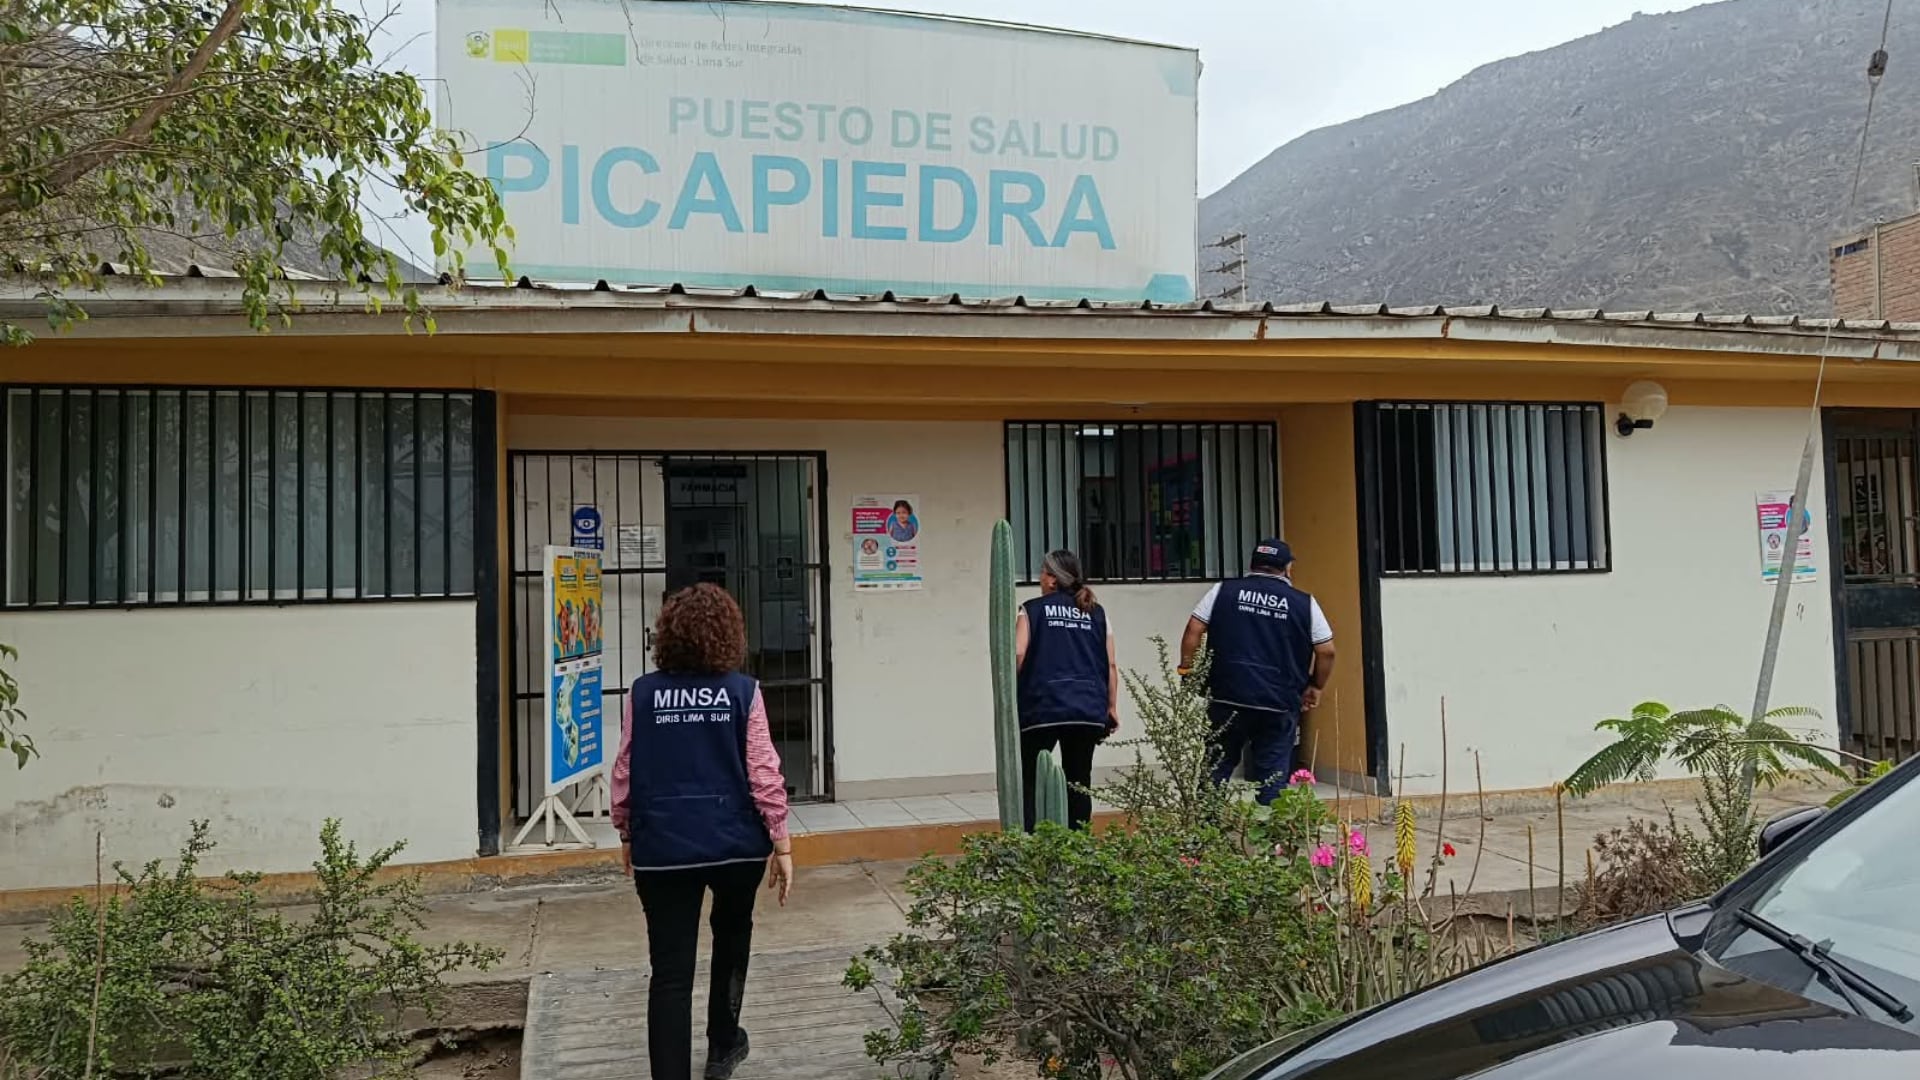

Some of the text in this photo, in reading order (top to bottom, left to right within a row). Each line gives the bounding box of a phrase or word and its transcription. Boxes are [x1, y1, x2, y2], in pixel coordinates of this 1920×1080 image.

[669, 96, 1121, 163] PUESTO DE SALUD
[486, 139, 1117, 251] PICAPIEDRA
[1238, 589, 1290, 610] MINSA
[1044, 604, 1092, 621] MINSA
[1274, 611, 1288, 621] SUR
[653, 687, 732, 709] MINSA
[656, 713, 731, 724] DIRIS LIMA SUR
